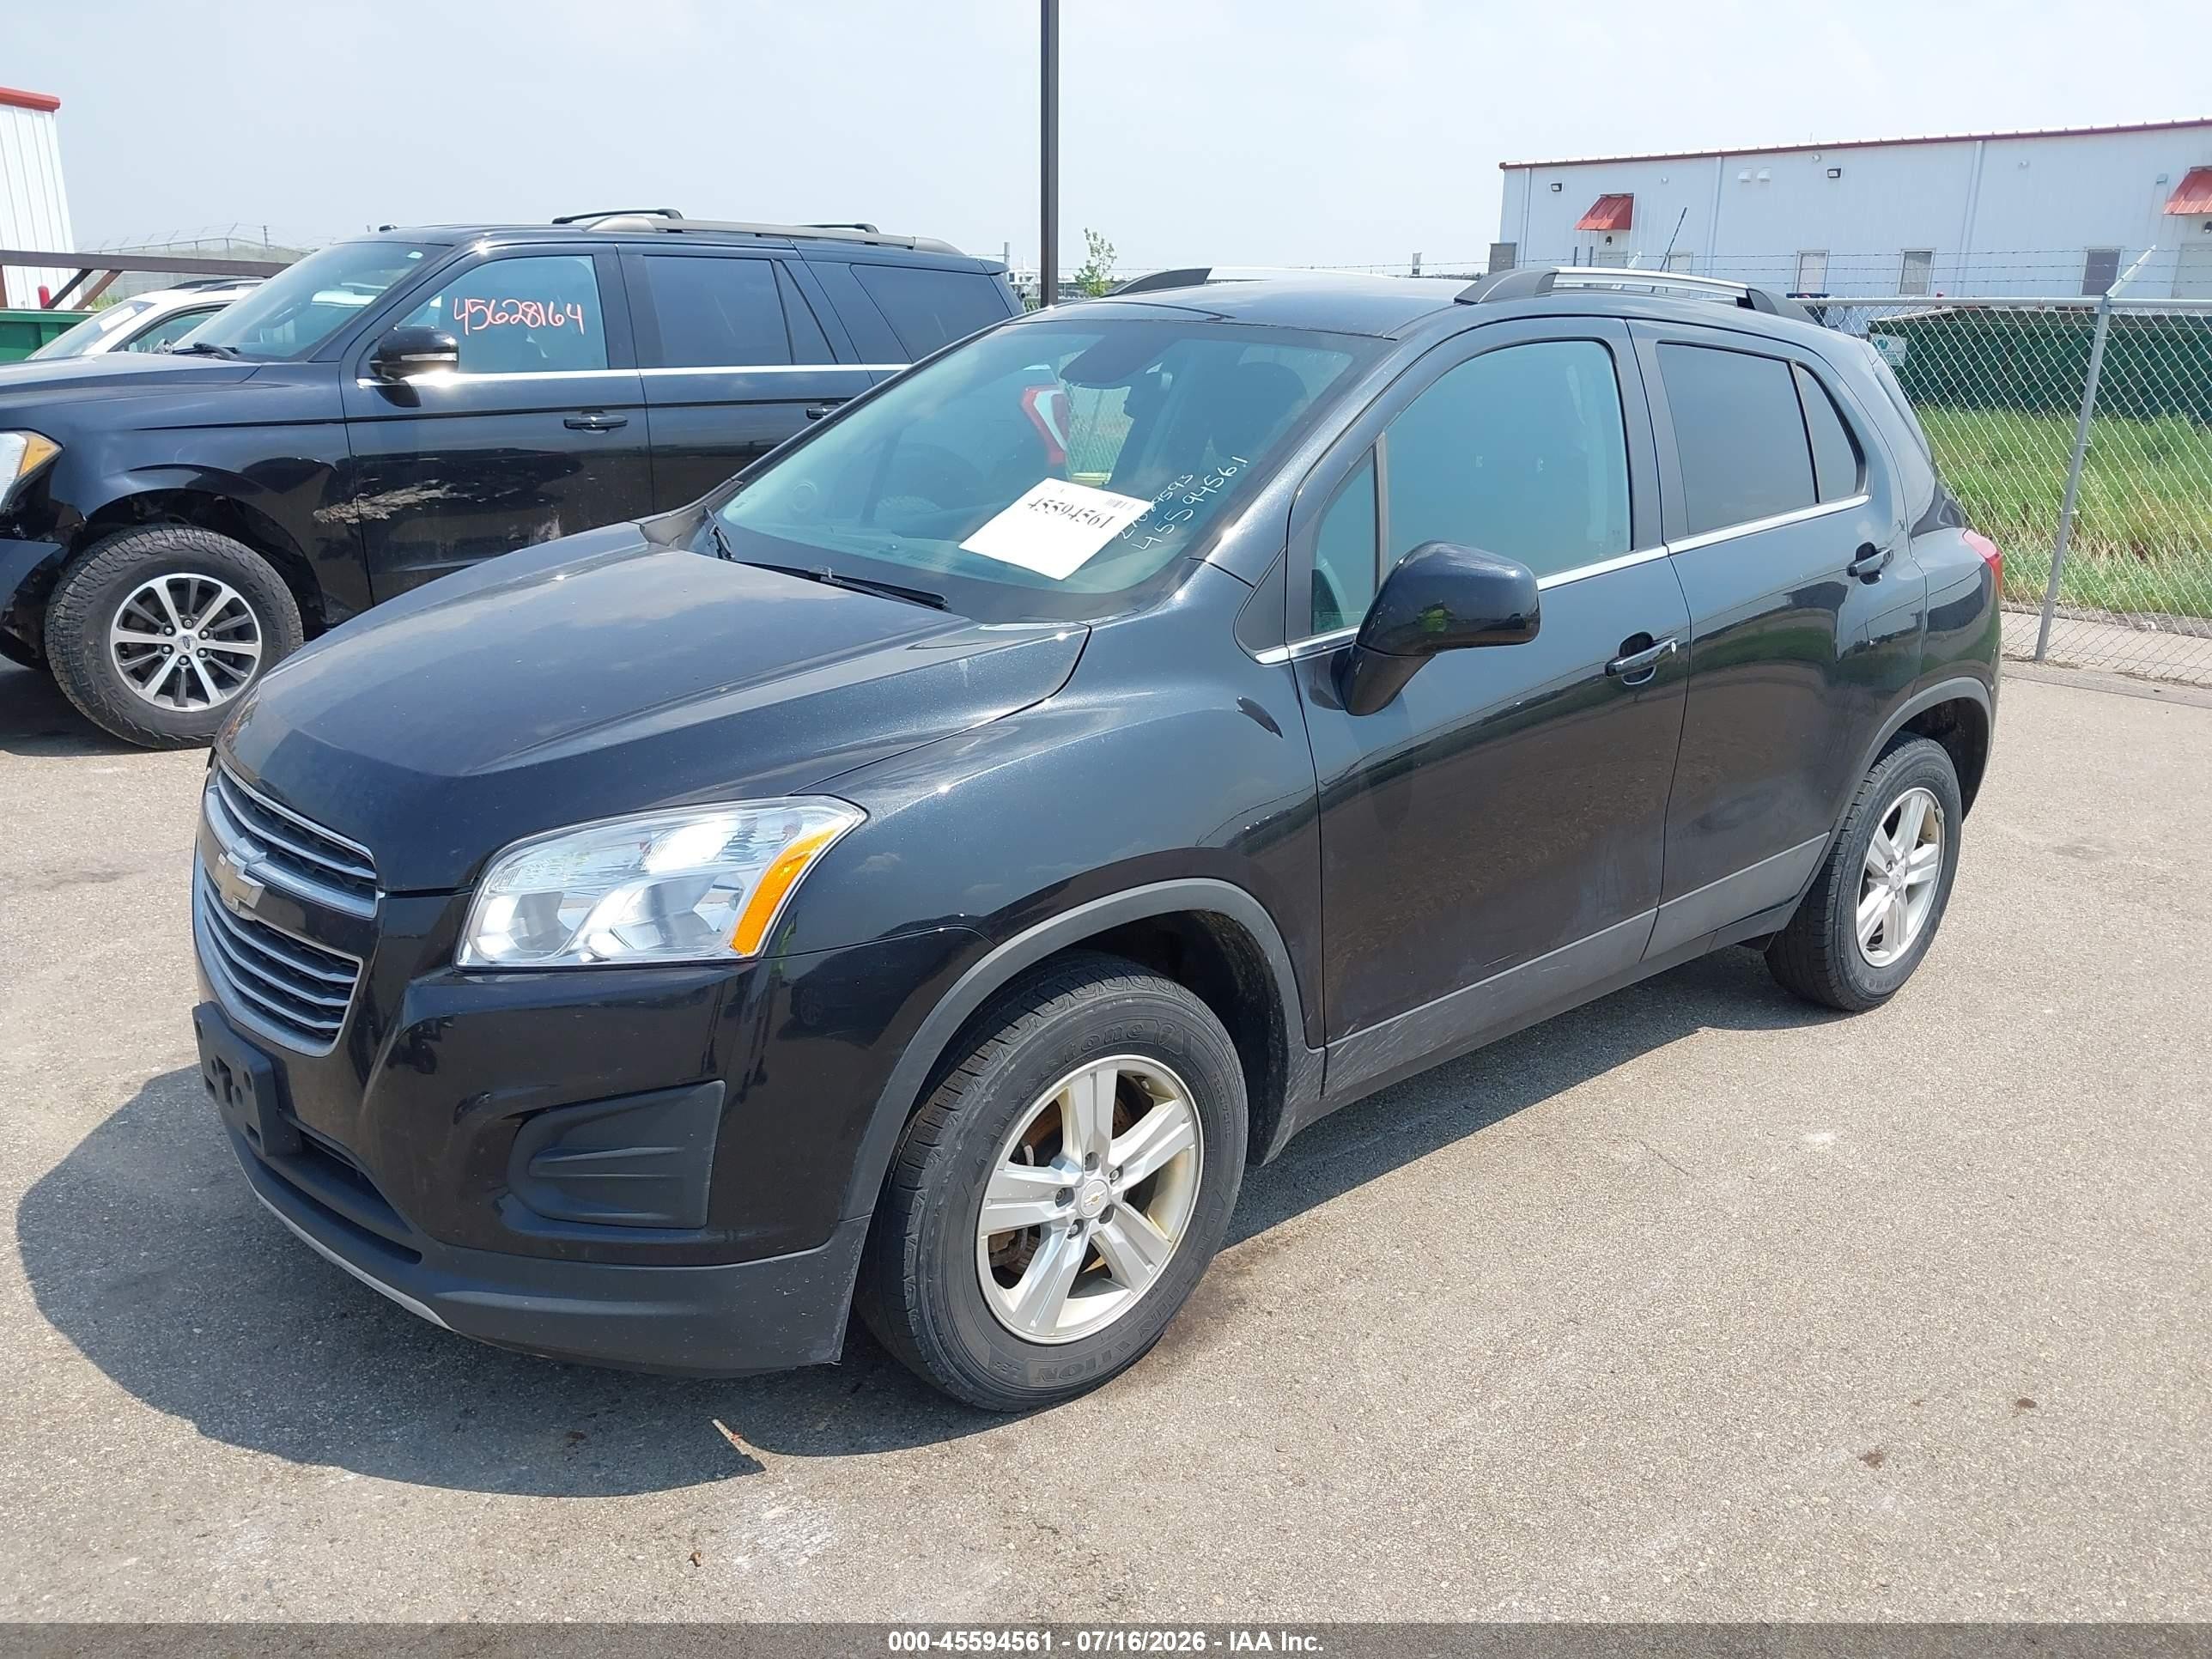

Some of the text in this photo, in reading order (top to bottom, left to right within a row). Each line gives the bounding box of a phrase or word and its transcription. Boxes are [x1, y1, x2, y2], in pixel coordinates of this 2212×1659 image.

[453, 297, 585, 336] 45628164
[1027, 497, 1115, 528] 45594561
[1131, 455, 1249, 550] 45594561
